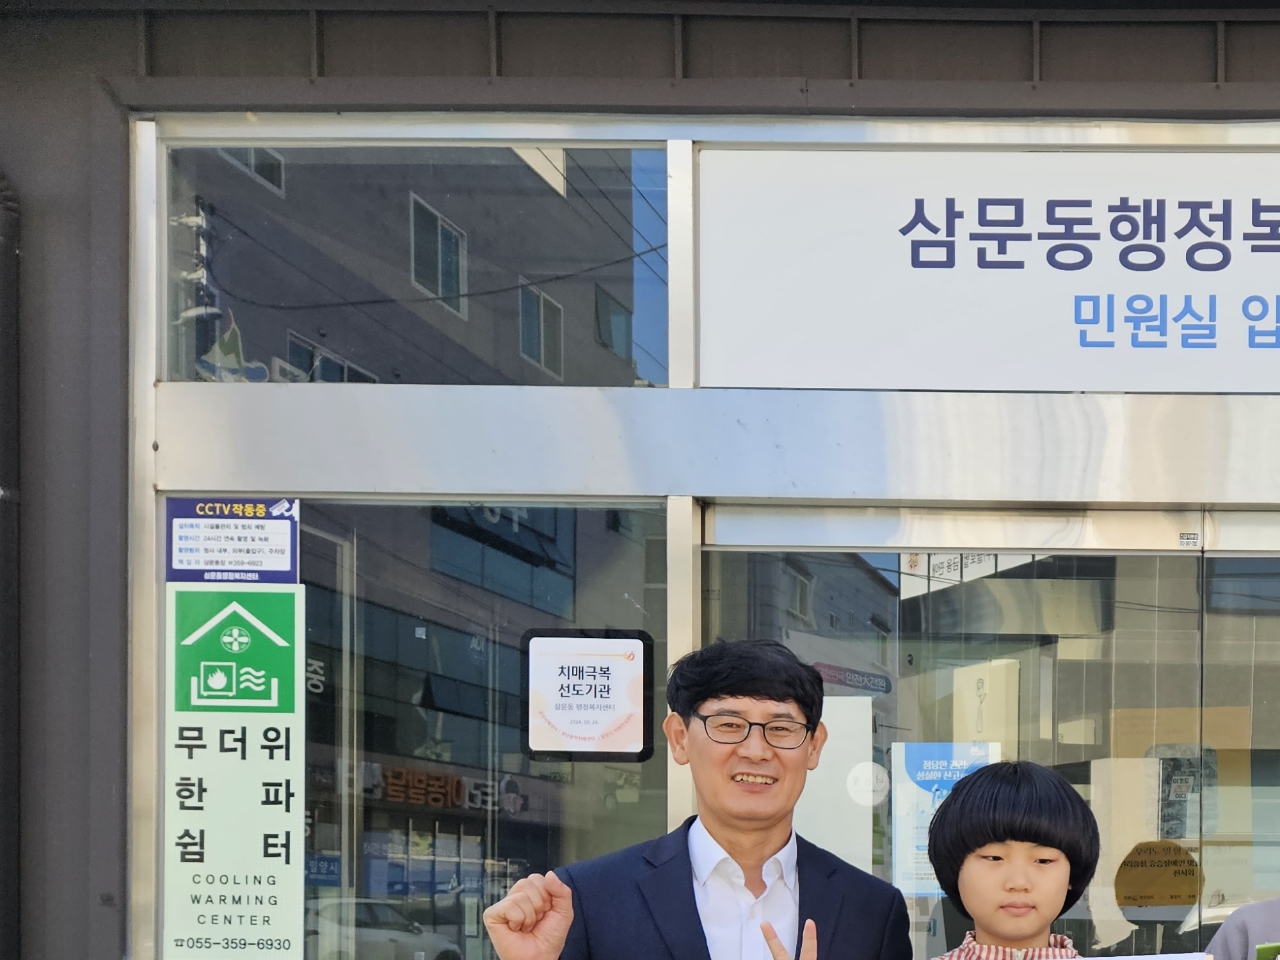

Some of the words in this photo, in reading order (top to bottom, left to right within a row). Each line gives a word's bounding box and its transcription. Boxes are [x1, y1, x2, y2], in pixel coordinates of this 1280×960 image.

[1073, 293, 1218, 349] 민원실
[195, 502, 267, 518] CCTV작동중
[558, 665, 612, 681] 치매극복
[558, 683, 612, 699] 선도기관
[554, 702, 575, 711] 삼문동
[174, 726, 291, 761] 무더위
[192, 875, 277, 885] COOLING
[190, 895, 278, 906] WARMING
[196, 915, 272, 925] CENTER
[186, 937, 291, 951] 055-359-6930
